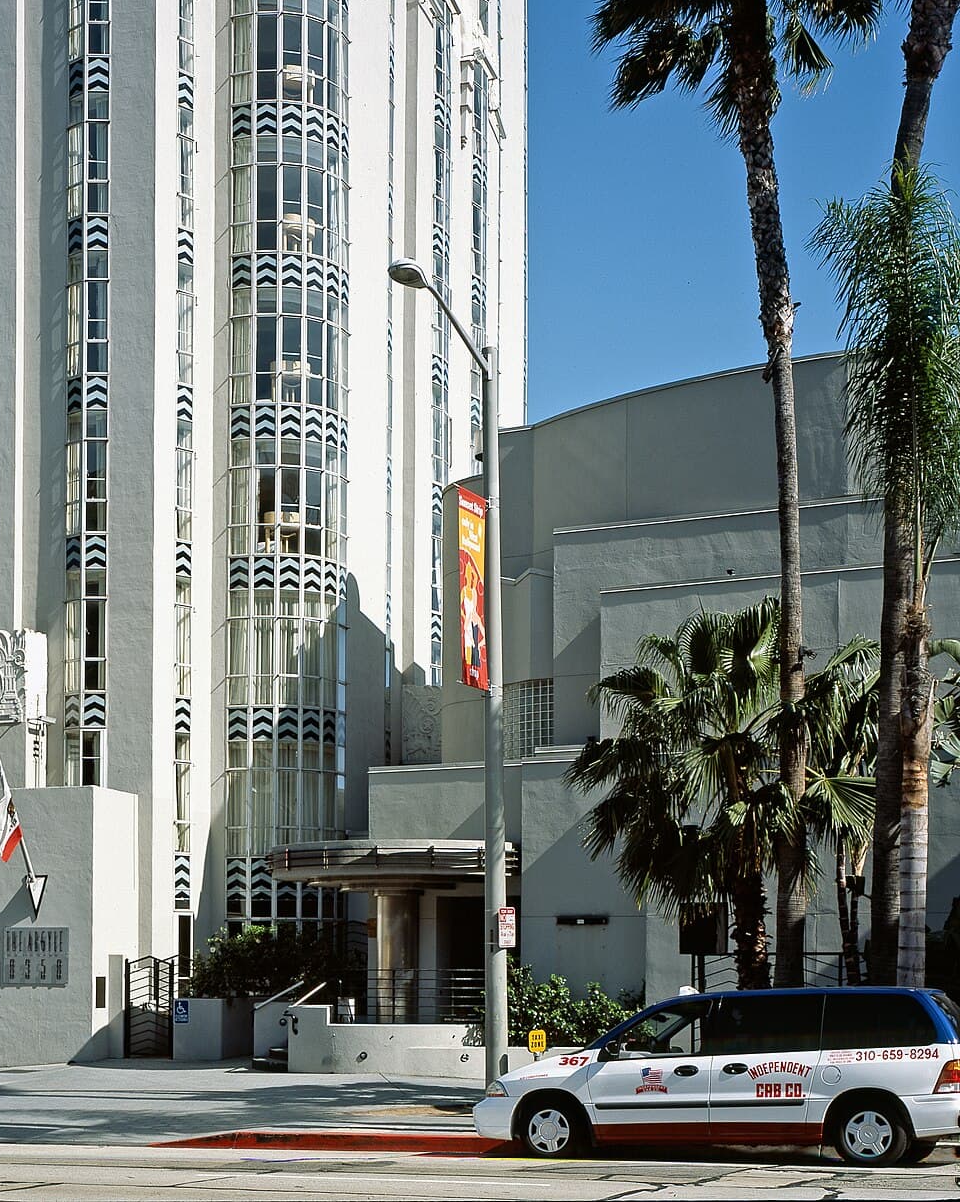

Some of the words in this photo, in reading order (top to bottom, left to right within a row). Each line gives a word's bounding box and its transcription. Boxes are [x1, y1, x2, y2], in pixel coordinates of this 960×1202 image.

[6, 931, 22, 952] THE
[28, 931, 63, 952] ARGYLE
[558, 1056, 590, 1066] 367
[855, 1048, 939, 1061] 310-659-8294
[747, 1061, 812, 1080] INDEPENDENT
[756, 1083, 782, 1097] CAB
[785, 1083, 806, 1097] CO.
